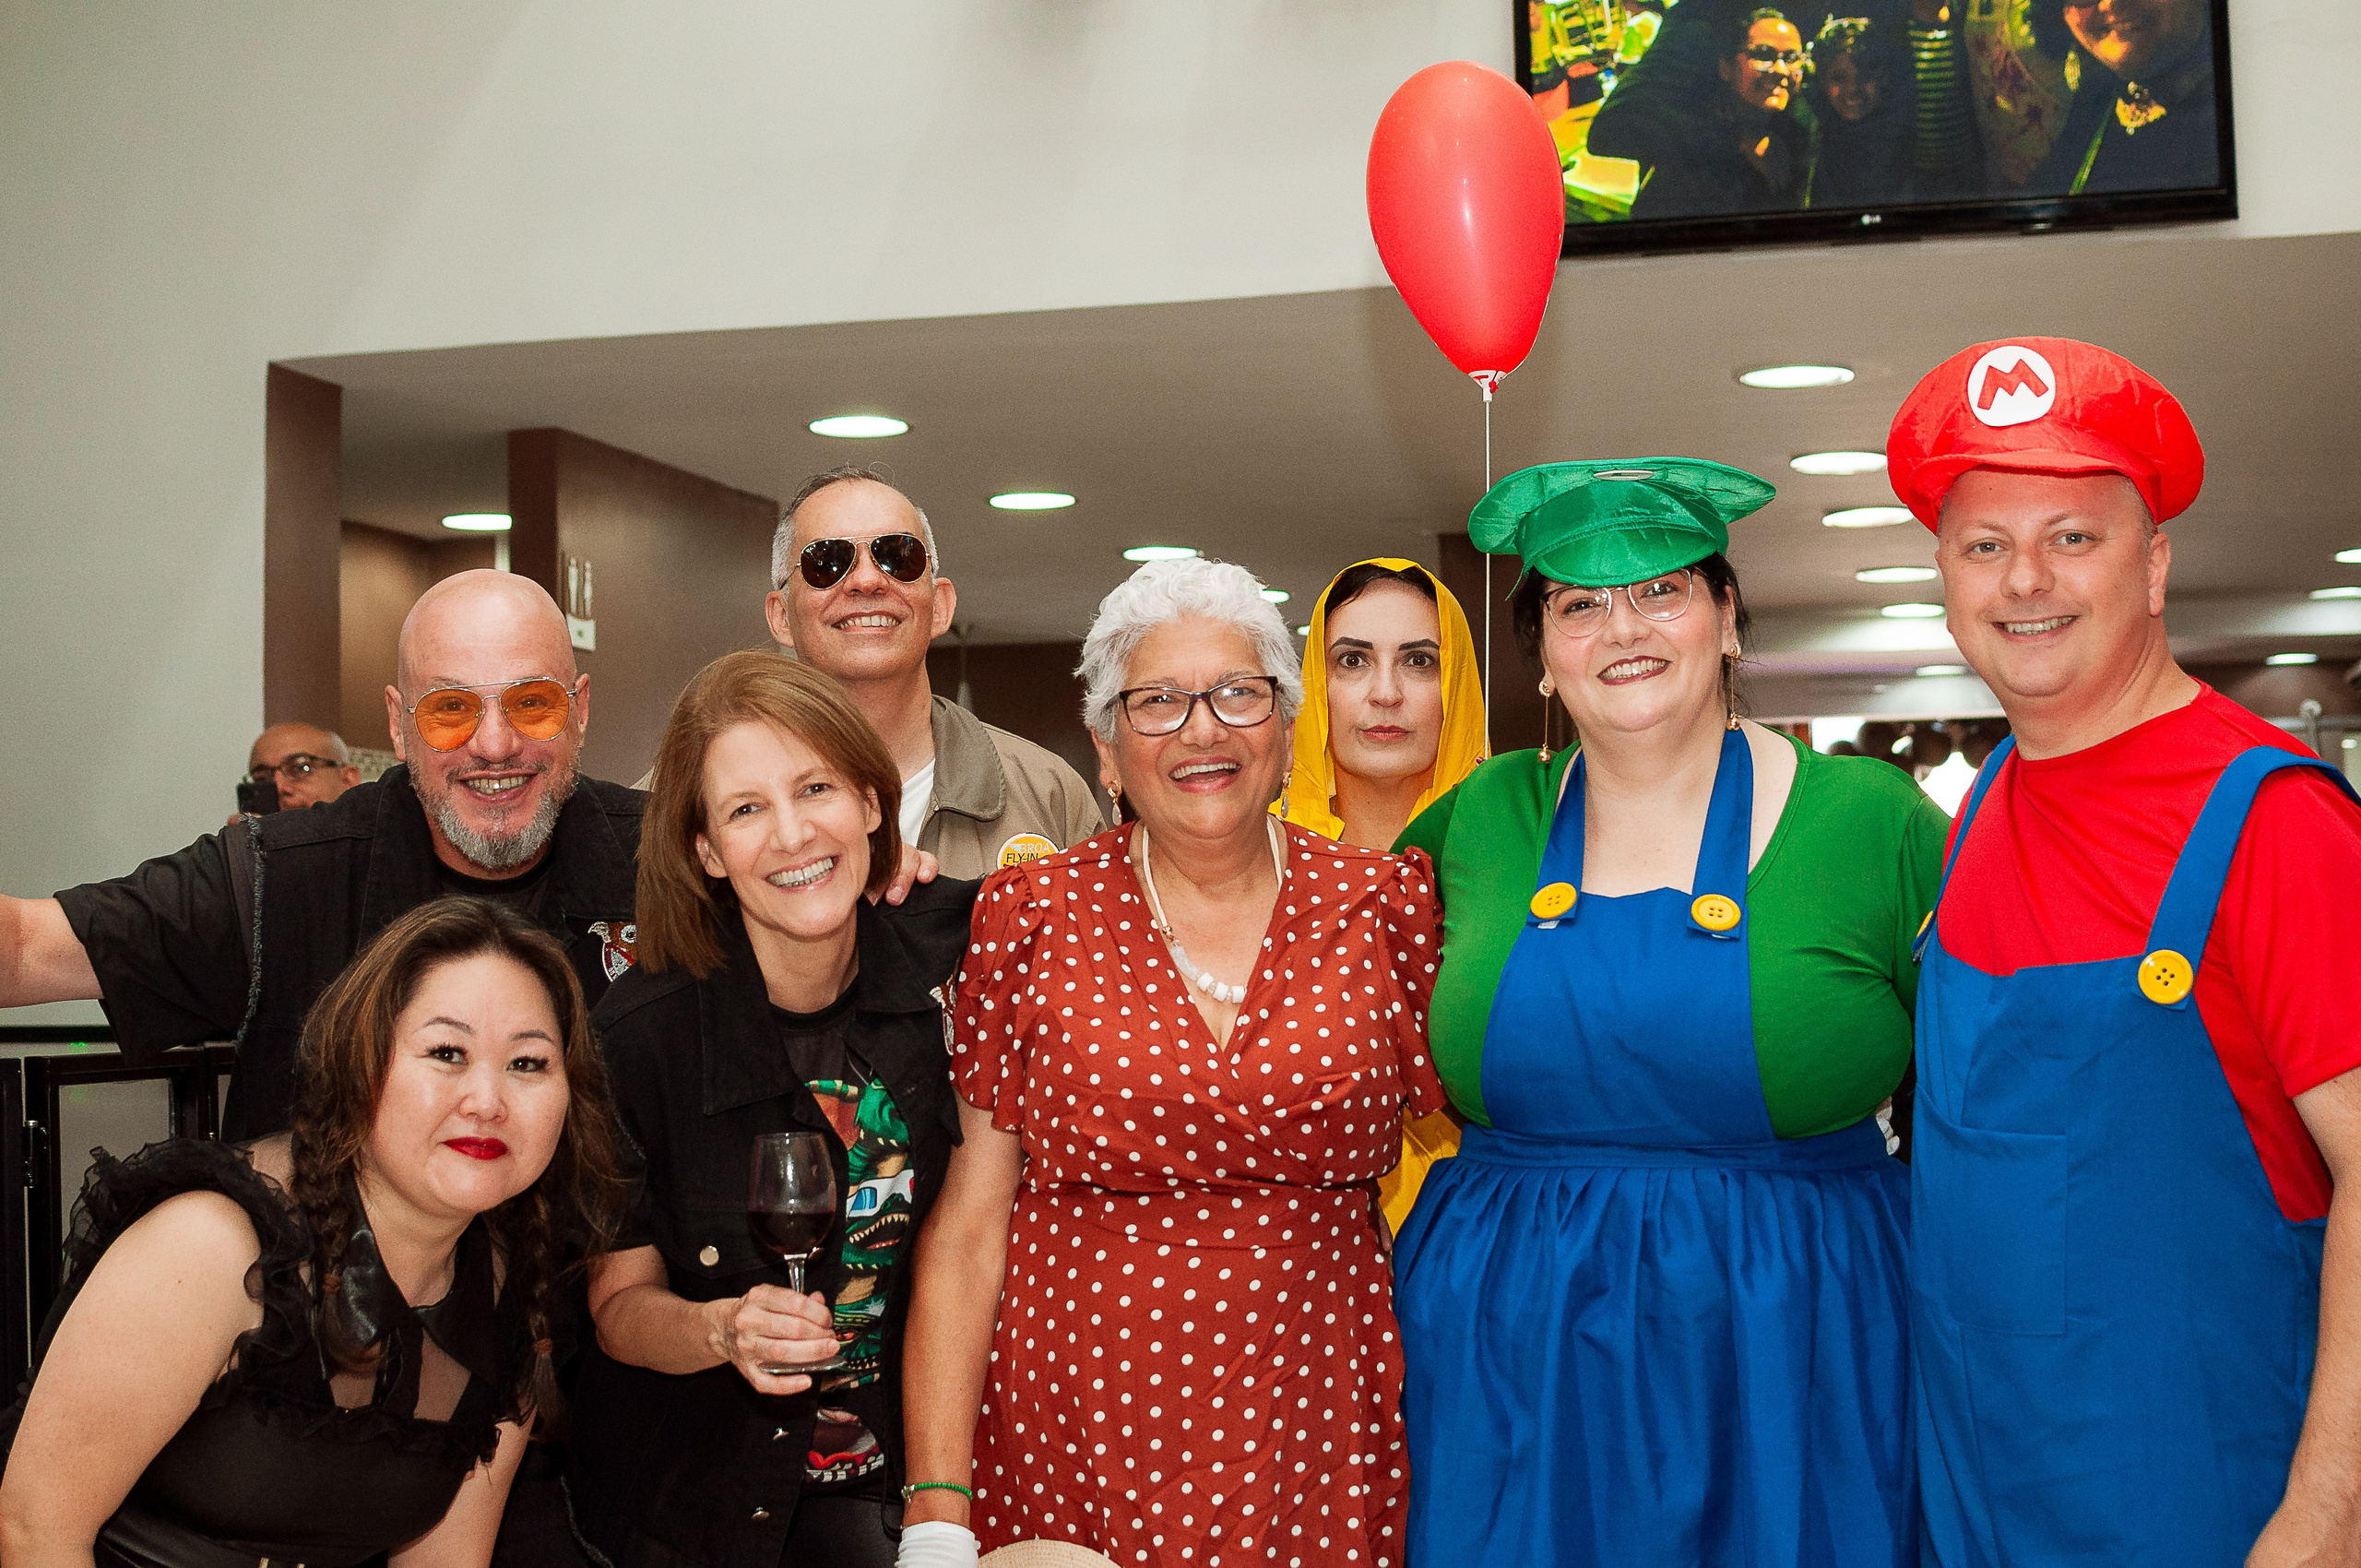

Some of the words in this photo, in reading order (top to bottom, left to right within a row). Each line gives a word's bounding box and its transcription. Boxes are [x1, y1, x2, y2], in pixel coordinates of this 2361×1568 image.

[1977, 359, 2049, 410] M
[1020, 843, 1050, 853] BROA
[1006, 853, 1038, 863] FLY-IN
